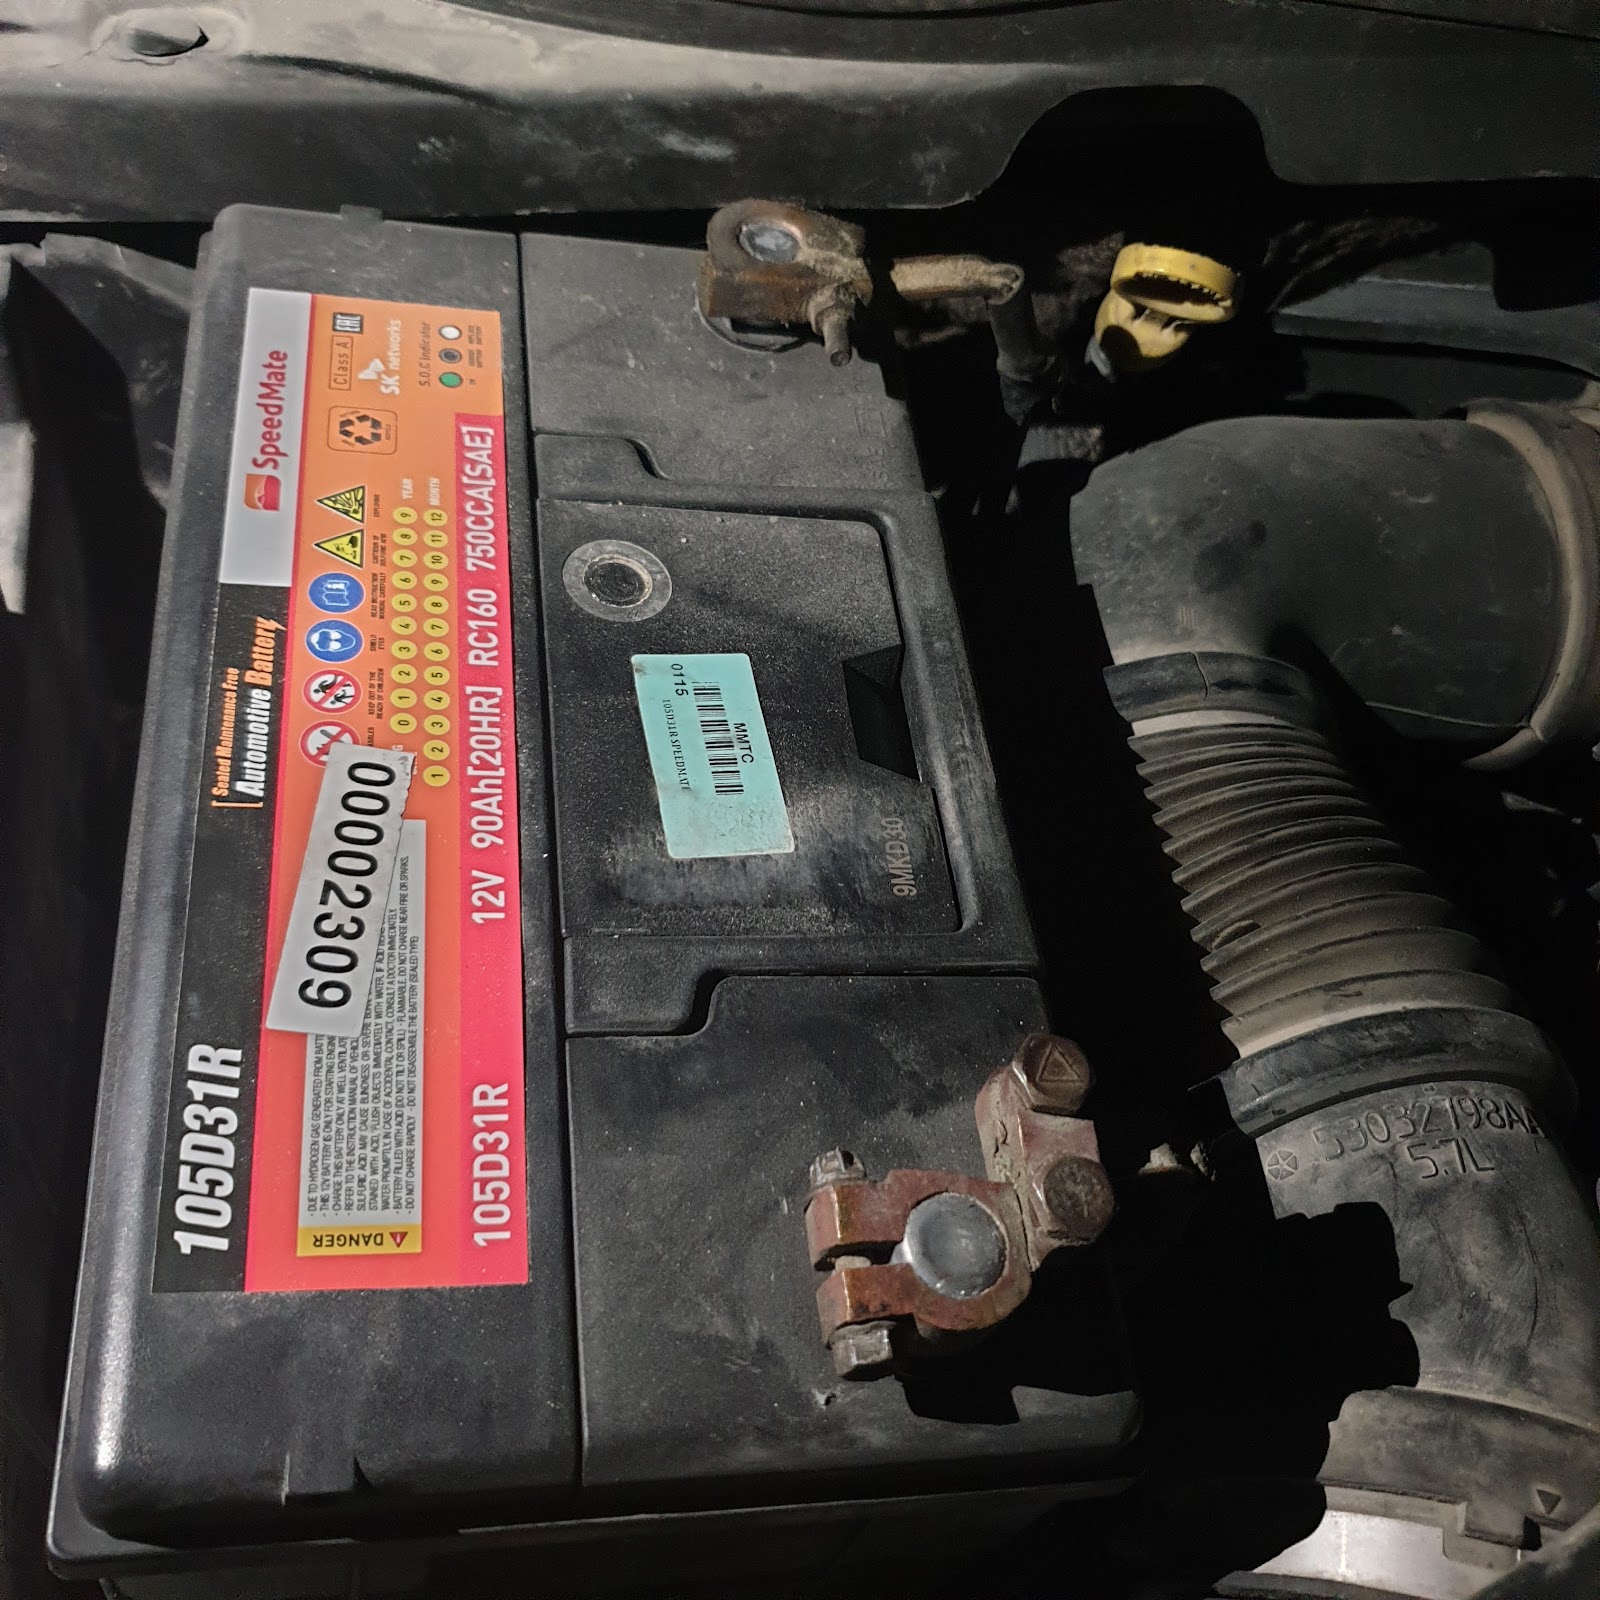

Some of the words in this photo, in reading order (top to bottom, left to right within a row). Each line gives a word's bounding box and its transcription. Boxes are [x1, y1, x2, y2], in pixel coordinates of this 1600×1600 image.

[387, 320, 401, 370] networks
[419, 322, 431, 360] Indicator
[334, 353, 348, 384] Class
[380, 373, 400, 395] SK
[402, 479, 413, 499] YEAR
[428, 478, 440, 506] MONTH
[460, 426, 496, 571] 750CCA[SAE]
[466, 589, 499, 666] RC160
[244, 616, 287, 686] Battery
[220, 668, 240, 690] Free
[671, 663, 689, 697] 0115
[215, 692, 237, 757] Maintenance
[662, 699, 679, 737] 105D31R
[235, 688, 272, 797] Automotive
[733, 722, 754, 764] MMTC
[212, 759, 231, 796] Sealed
[465, 685, 504, 849] 90Ah[20HR]
[298, 762, 396, 1008] 00002309
[471, 870, 505, 924] 12V
[173, 1044, 242, 1255] 105D31R
[472, 1083, 511, 1247] 105D31R
[1405, 1137, 1496, 1179] 5.7L
[313, 1233, 383, 1247] DANGER
